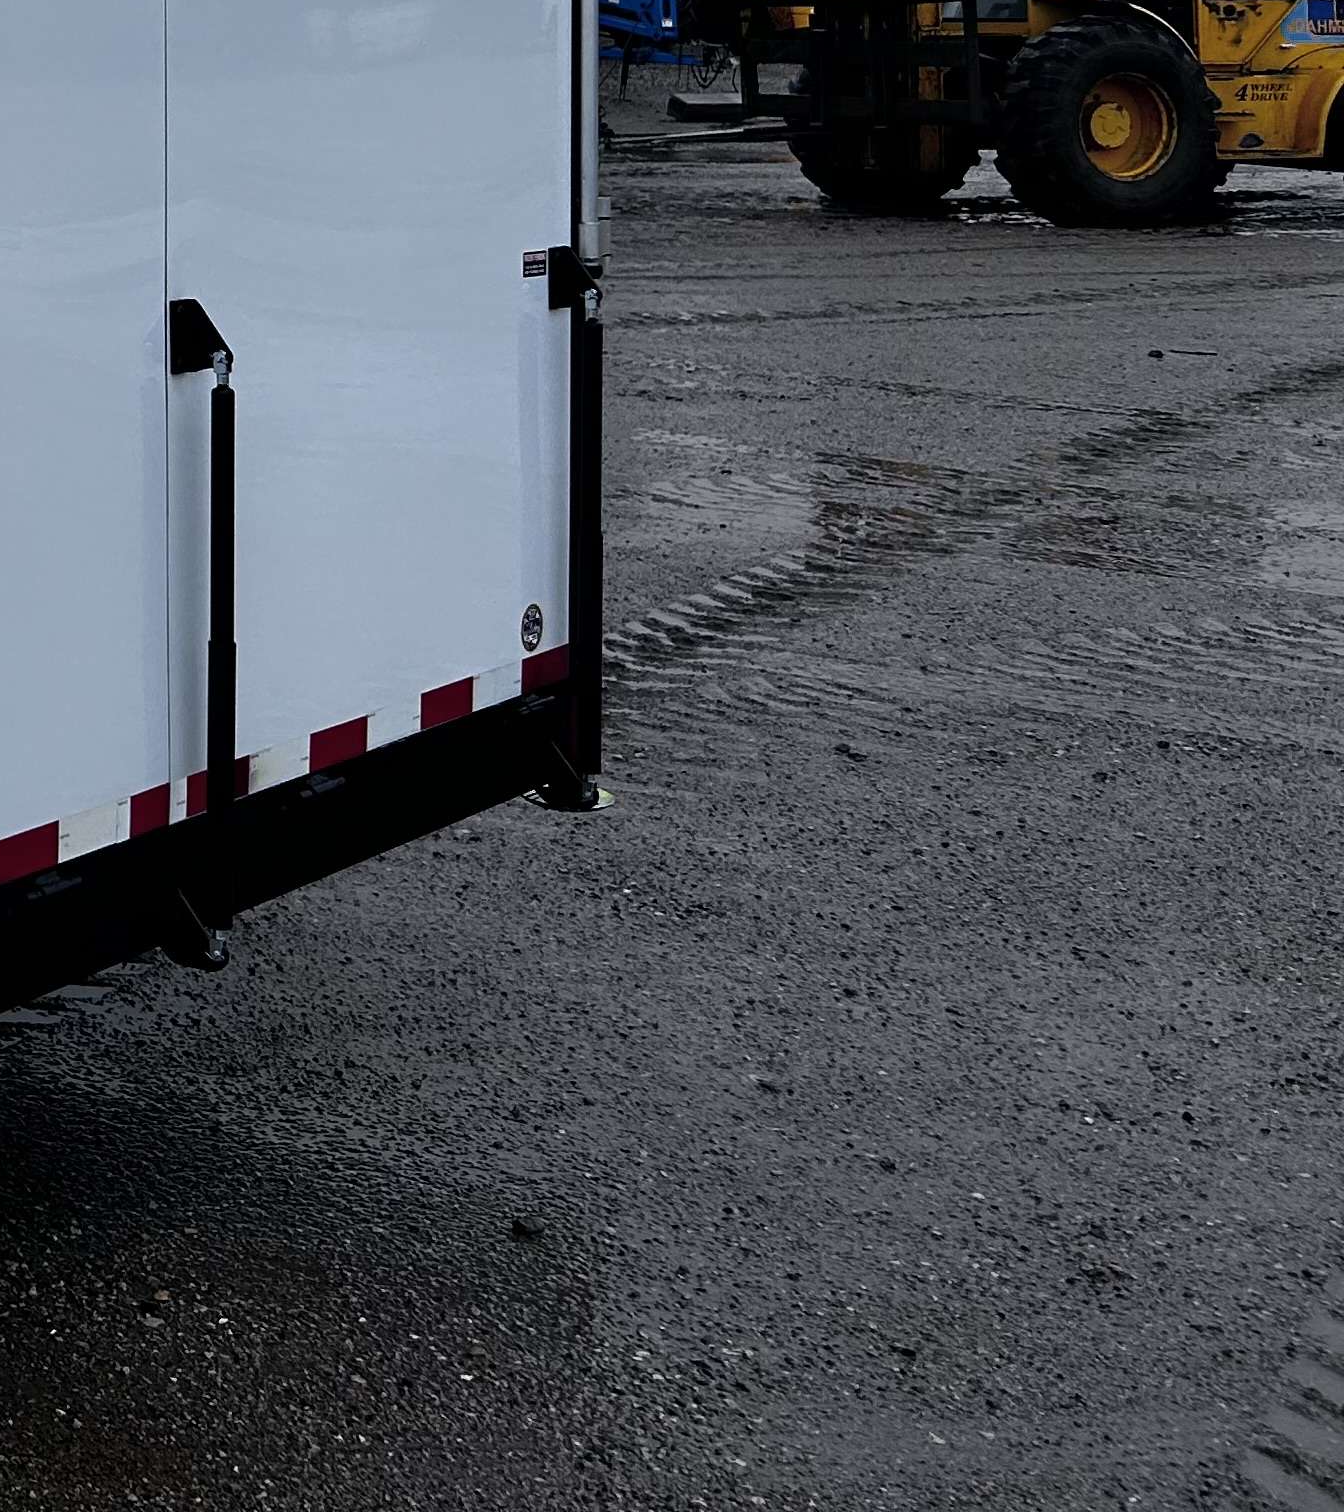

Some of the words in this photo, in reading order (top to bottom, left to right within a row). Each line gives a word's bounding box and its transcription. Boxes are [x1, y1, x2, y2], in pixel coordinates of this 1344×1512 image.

[1234, 83, 1249, 102] 4
[1249, 83, 1293, 92] WHEEL
[1250, 92, 1289, 101] DRIVE
